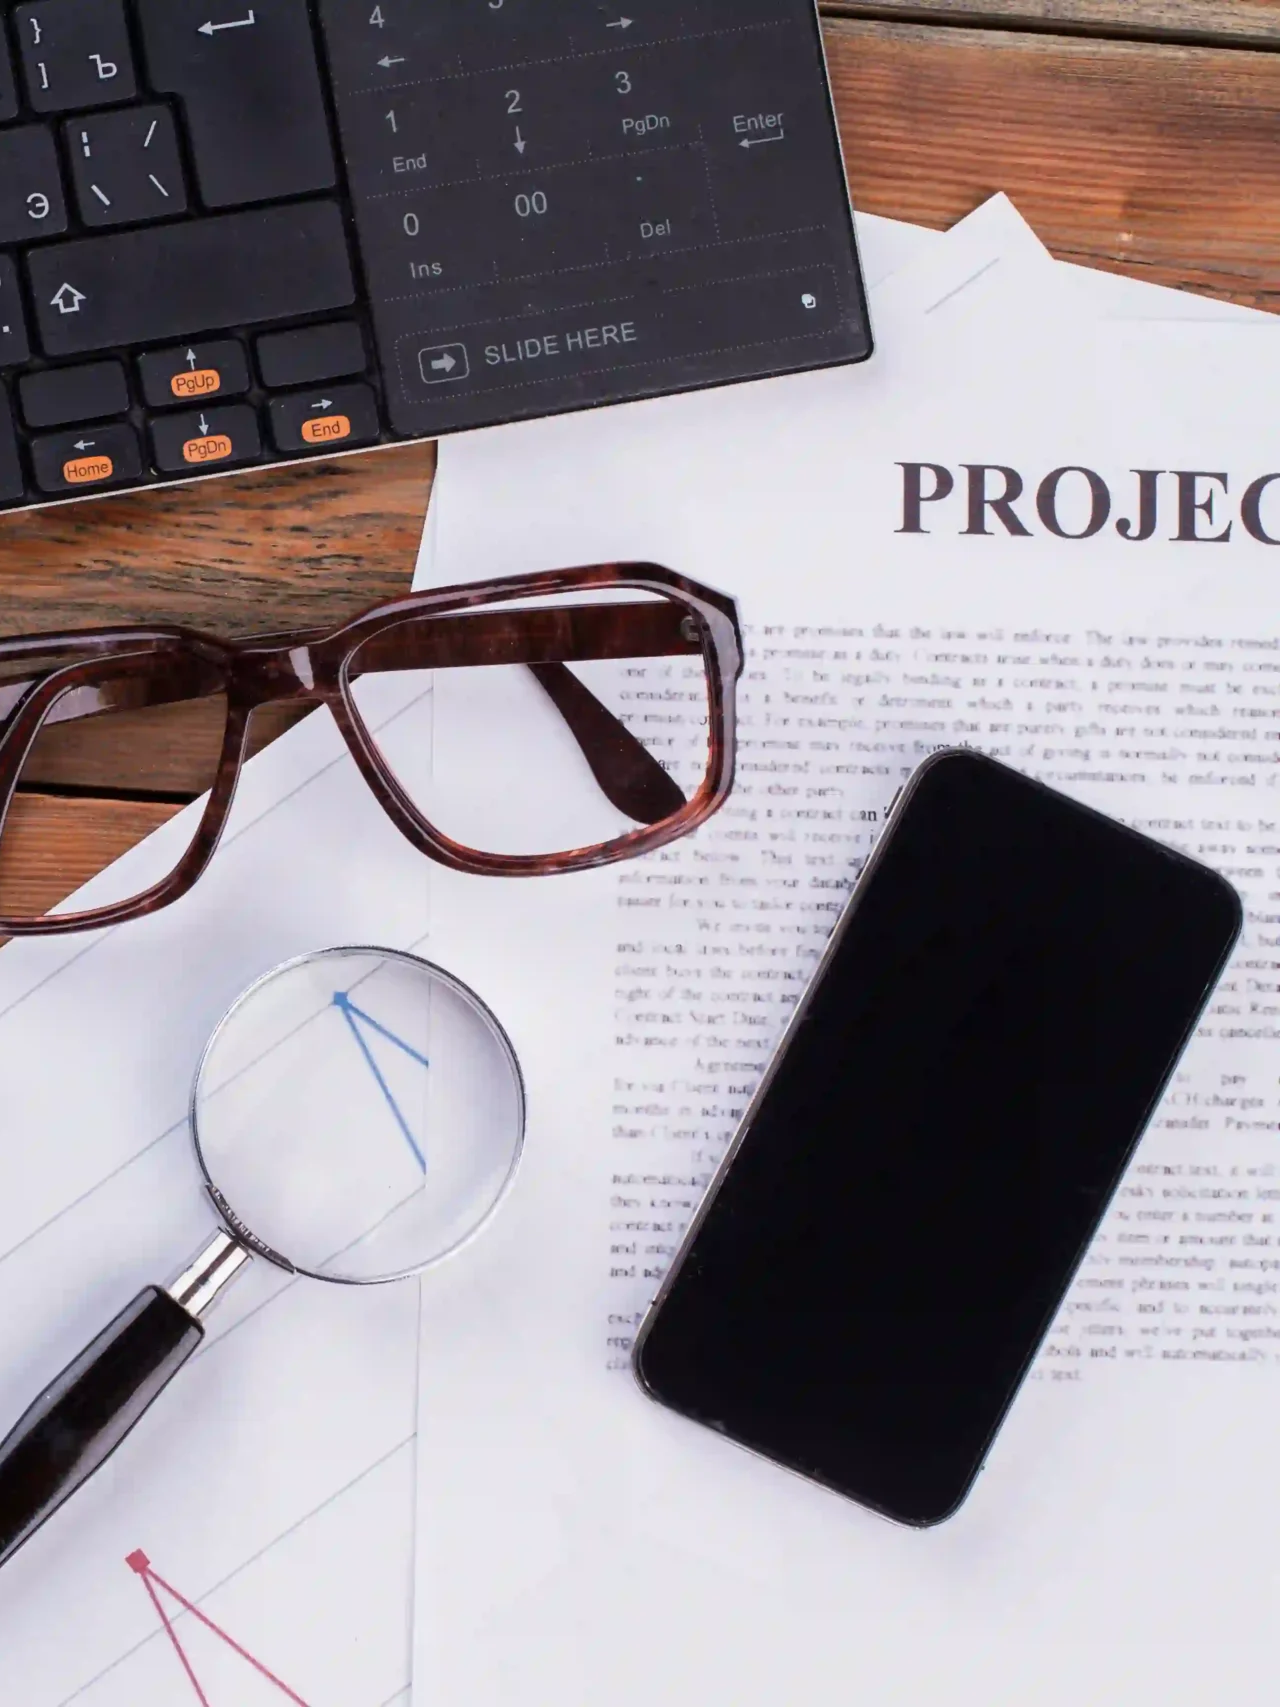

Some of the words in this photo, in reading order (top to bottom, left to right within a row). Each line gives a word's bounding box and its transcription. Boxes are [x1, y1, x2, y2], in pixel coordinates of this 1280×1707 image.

[370, 6, 384, 28] 4
[615, 71, 631, 93] 3
[505, 90, 522, 113] 2
[386, 110, 397, 132] 1
[622, 115, 669, 135] PgDn
[733, 113, 783, 132] Enter
[393, 153, 426, 172] End
[515, 192, 547, 216] 00
[404, 213, 419, 235] 0
[640, 219, 670, 238] Del
[410, 263, 442, 278] Ins
[485, 335, 559, 365] SLIDE
[566, 322, 636, 351] HERE
[176, 373, 215, 393] PgUp
[311, 419, 341, 438] End
[188, 439, 227, 459] PgDn
[66, 461, 110, 480] Home
[894, 462, 1280, 545] PROJEC
